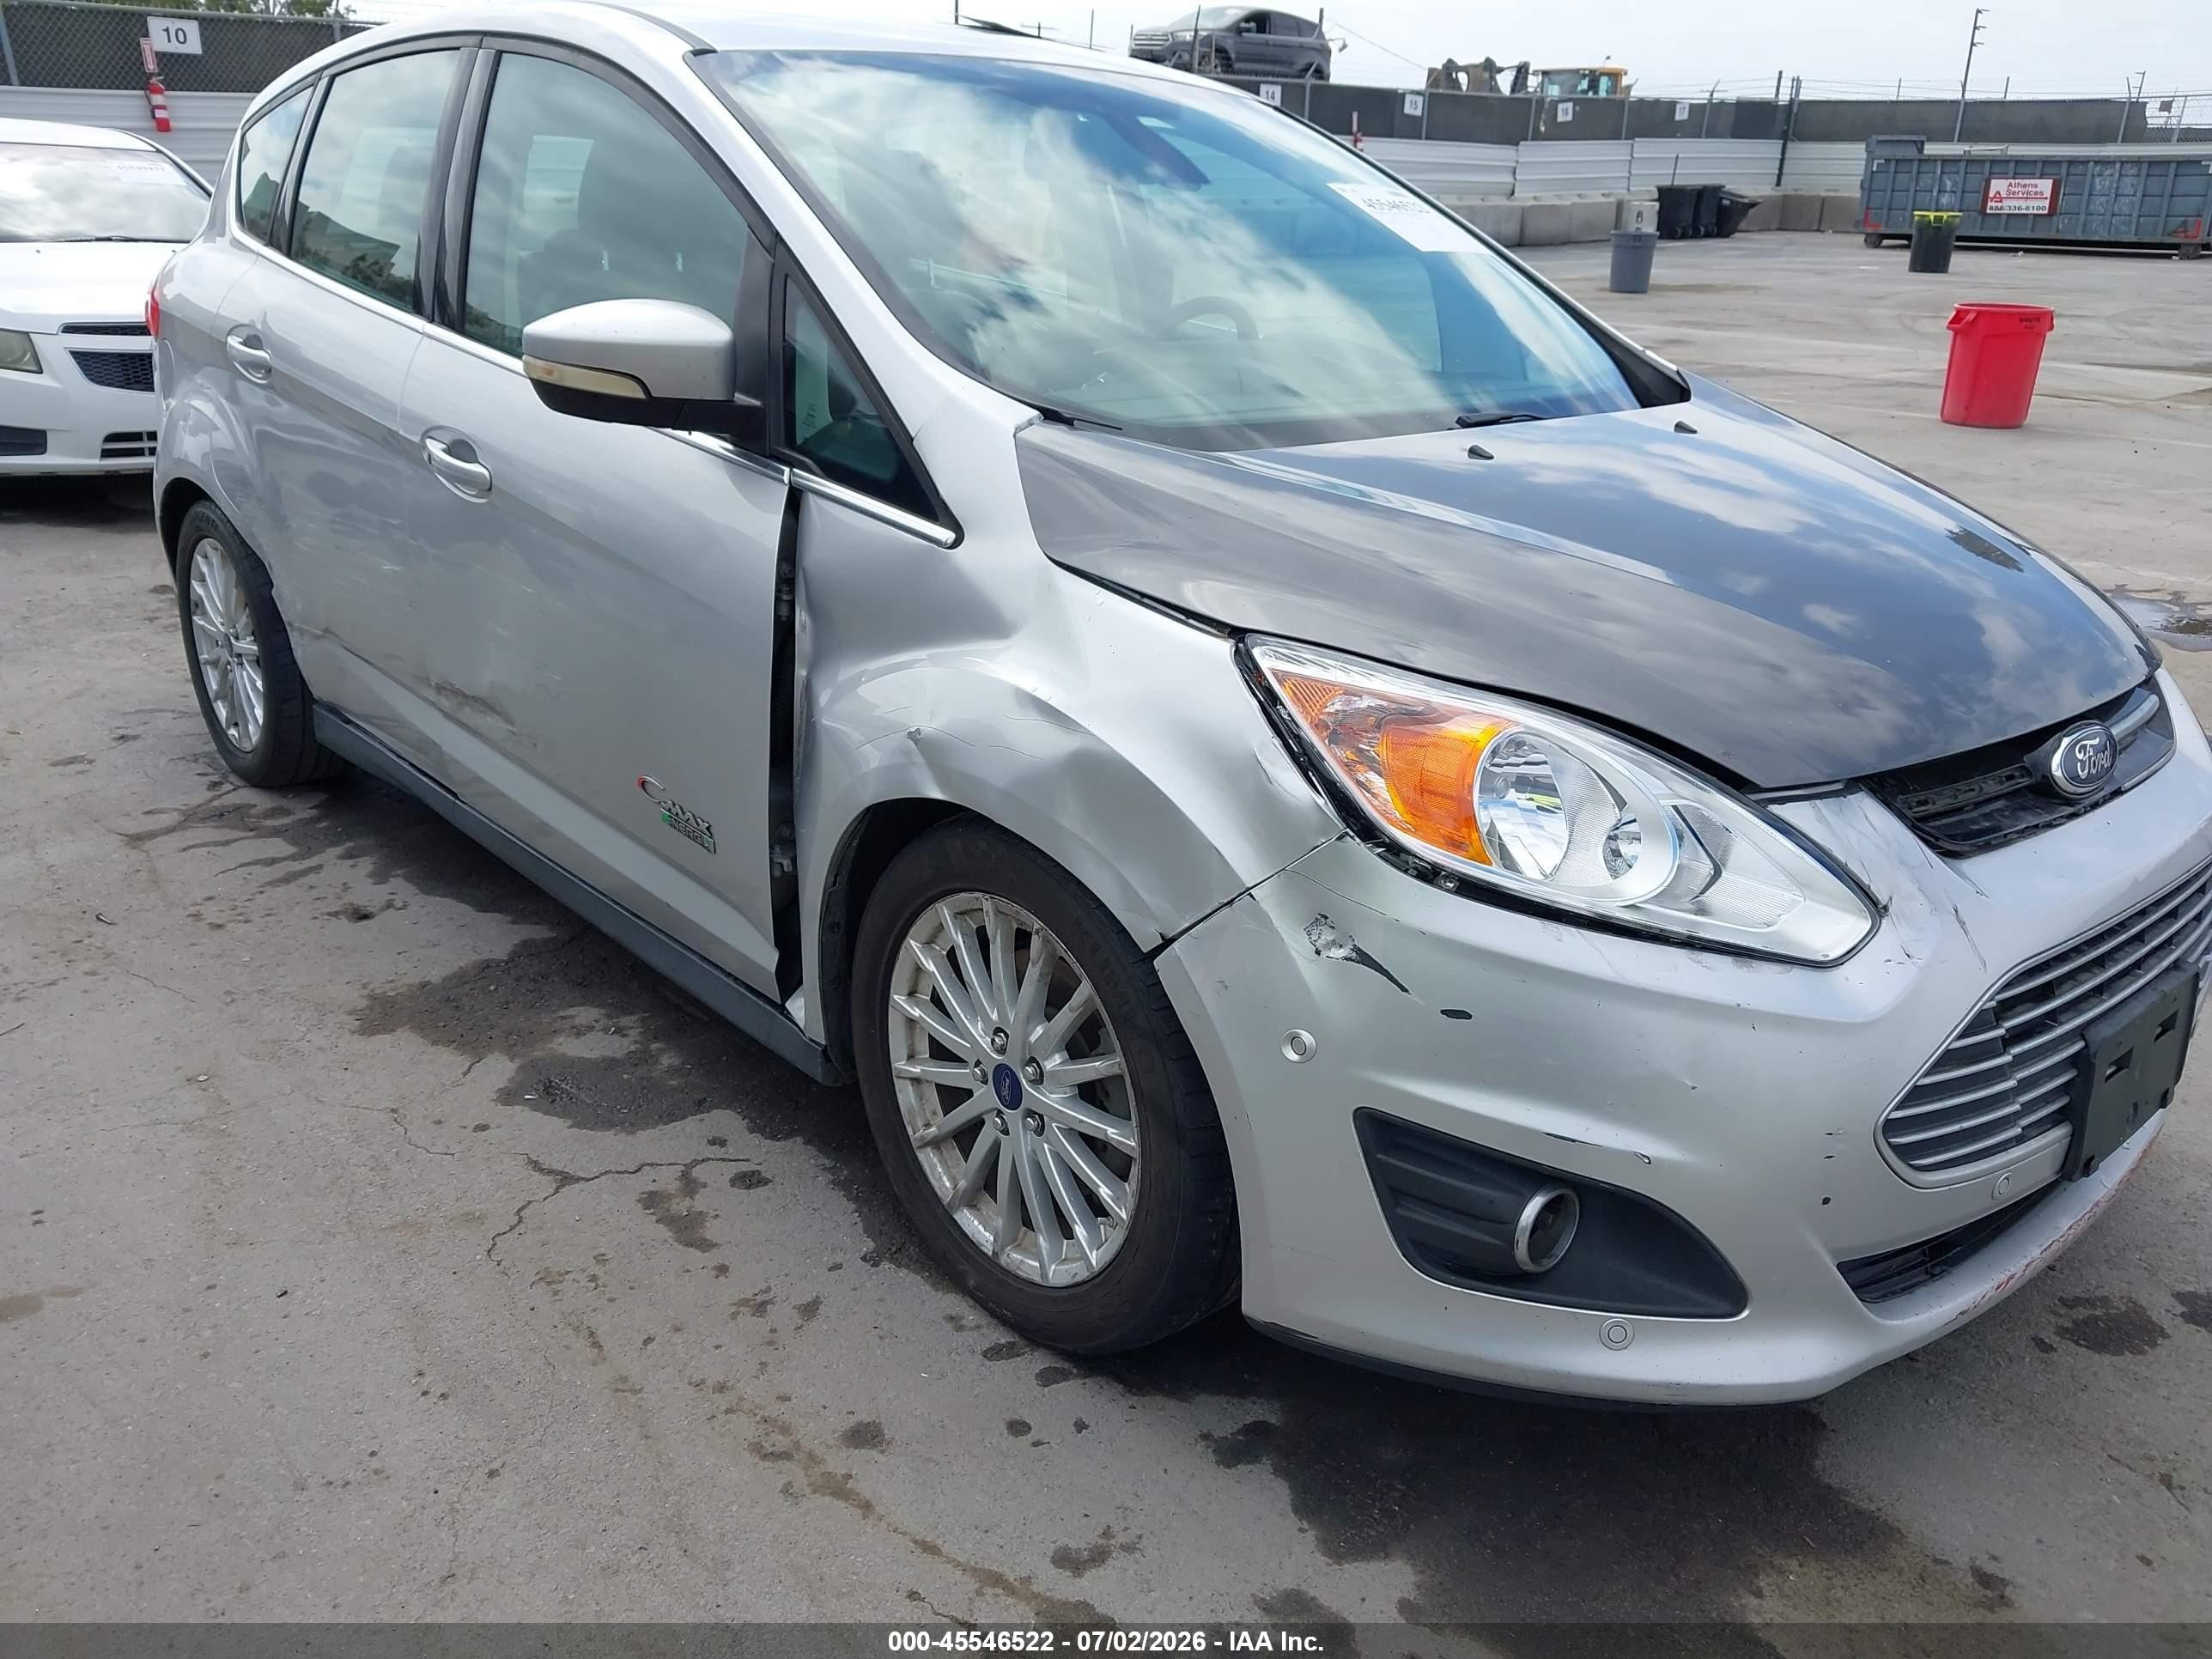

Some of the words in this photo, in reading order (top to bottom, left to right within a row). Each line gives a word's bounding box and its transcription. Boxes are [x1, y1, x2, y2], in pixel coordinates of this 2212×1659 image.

[162, 27, 187, 45] 10
[1266, 89, 1275, 101] 14
[2075, 736, 2112, 780] Ford
